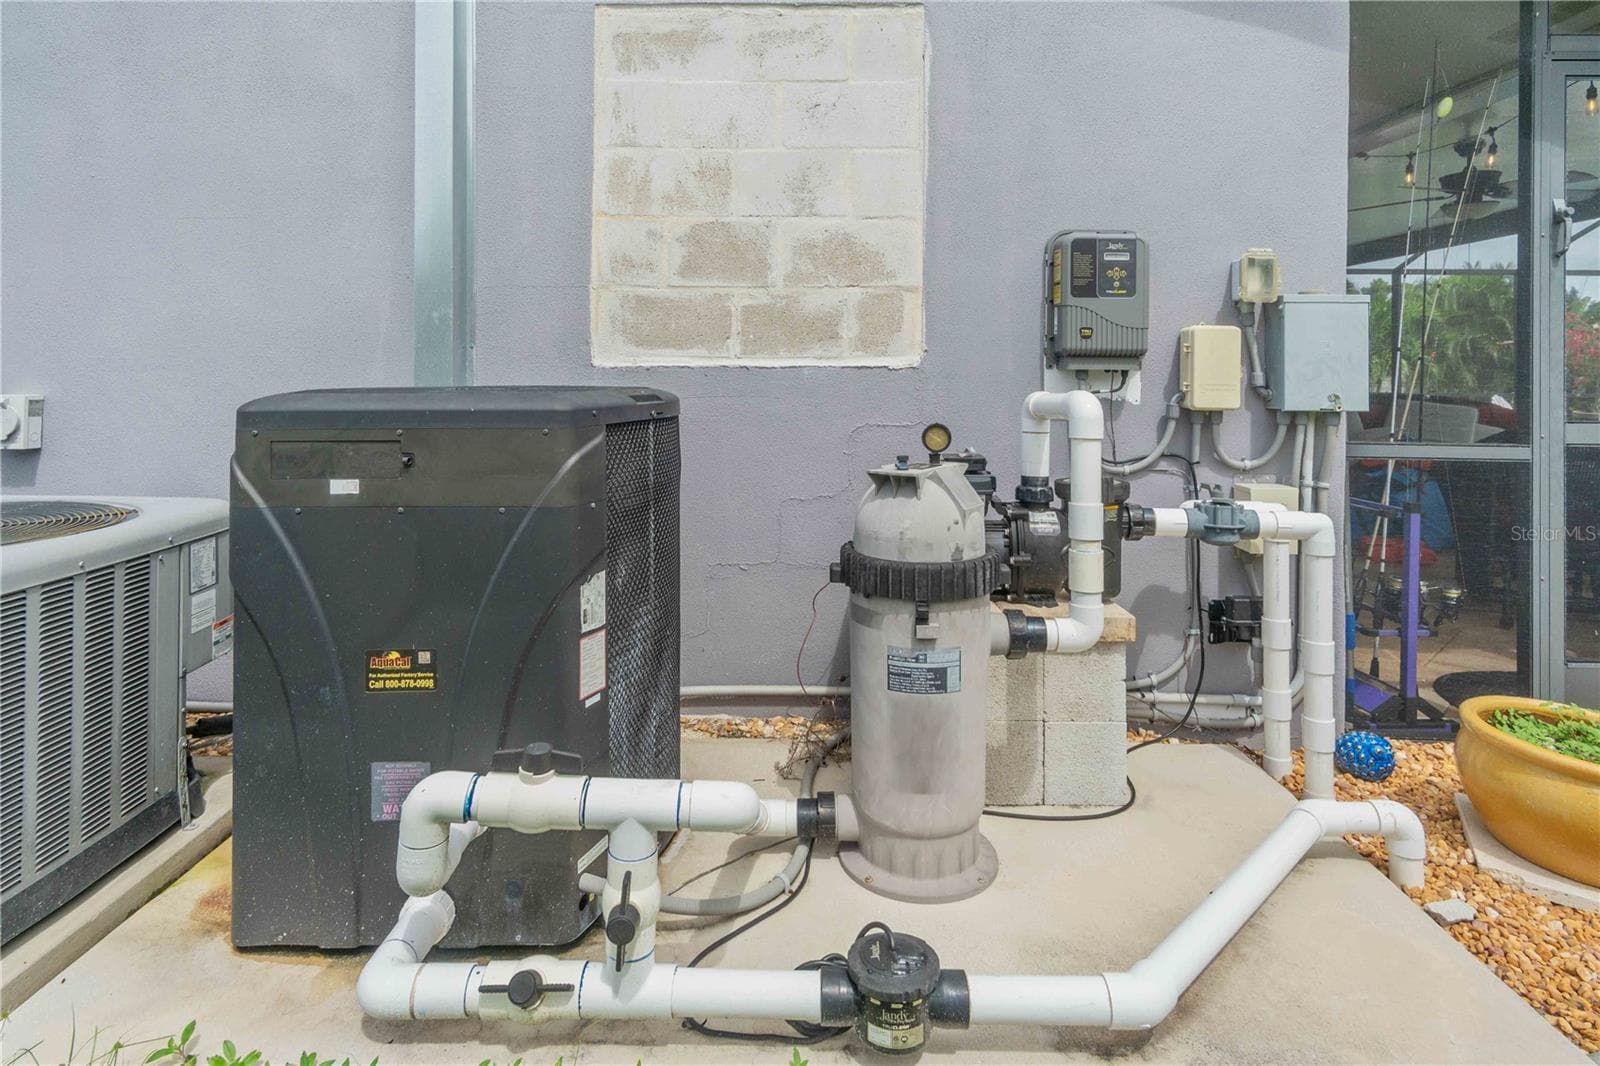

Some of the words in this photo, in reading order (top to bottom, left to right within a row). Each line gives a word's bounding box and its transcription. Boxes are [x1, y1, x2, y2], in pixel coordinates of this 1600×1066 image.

[370, 656, 411, 669] AquaCal
[369, 680, 384, 688] Call
[881, 1009, 915, 1022] Jandy
